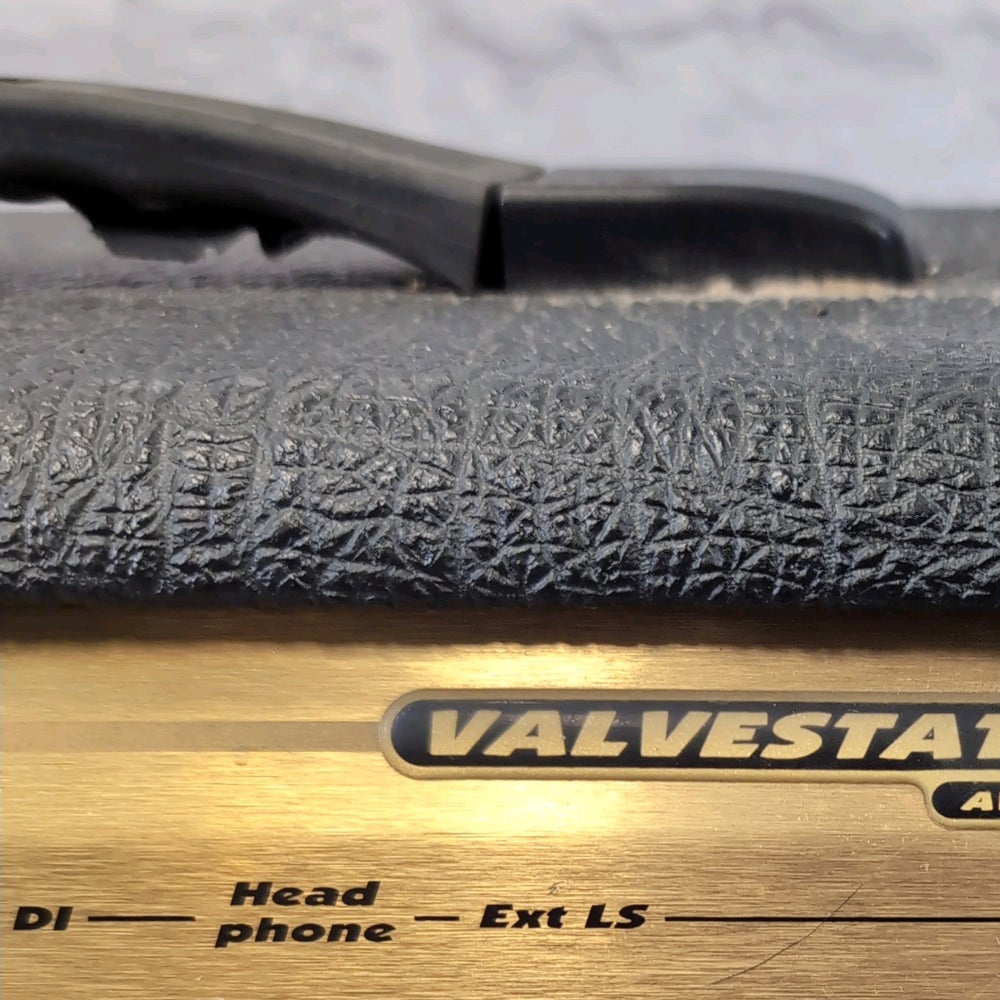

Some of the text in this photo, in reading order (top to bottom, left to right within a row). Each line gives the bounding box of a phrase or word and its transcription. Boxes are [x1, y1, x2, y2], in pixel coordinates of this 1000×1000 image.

[230, 880, 381, 907] Head
[12, 905, 74, 931] DI
[479, 904, 650, 930] Ext LS
[215, 917, 394, 949] phone
